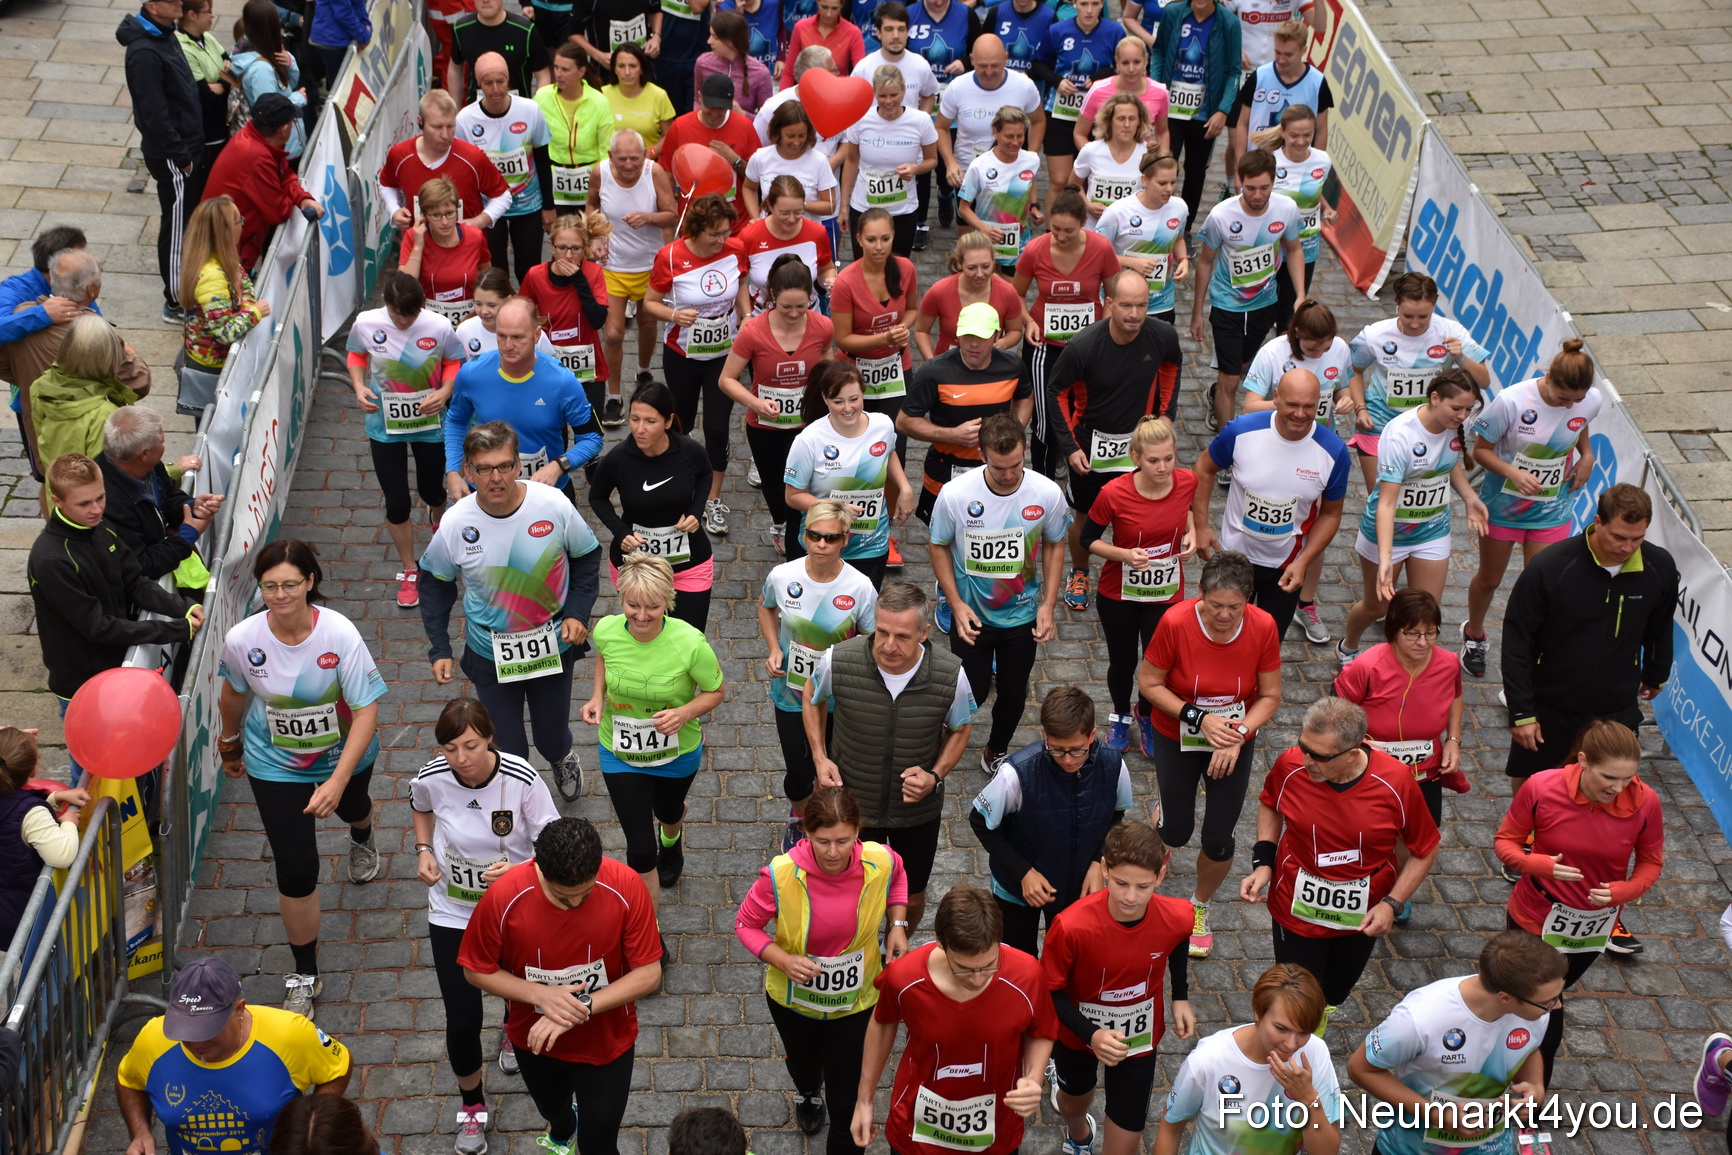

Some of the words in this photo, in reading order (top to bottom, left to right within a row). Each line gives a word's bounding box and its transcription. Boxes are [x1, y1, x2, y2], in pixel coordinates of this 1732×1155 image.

[614, 24, 643, 42] 5171
[908, 24, 930, 40] 45
[1000, 22, 1012, 35] 5
[1063, 38, 1074, 50] 8
[1059, 93, 1083, 108] 503
[1170, 90, 1202, 107] 5005
[1254, 88, 1280, 104] 66
[494, 158, 524, 174] 301
[556, 176, 589, 192] 5145
[869, 178, 904, 195] 5014
[1094, 185, 1132, 200] 5193
[1232, 253, 1272, 275] 5319
[1050, 314, 1090, 332] 5034
[692, 324, 729, 344] 5039
[863, 364, 898, 384] 5096
[1394, 379, 1424, 396] 511
[390, 402, 422, 418] 508
[1097, 441, 1127, 458] 532
[1404, 486, 1446, 507] 5077
[1248, 502, 1293, 524] 2535
[532, 524, 552, 533] Hervis
[986, 533, 1014, 541] Neumarkt
[640, 536, 684, 556] 5317
[970, 541, 1019, 560] 5025
[976, 563, 1014, 572] Alexander
[1129, 566, 1176, 586] 5087
[1136, 588, 1166, 596] Sabrina
[516, 629, 544, 640] Neumarkt
[501, 635, 552, 662] 5191
[500, 658, 559, 676] Kai-Sebastian
[794, 655, 815, 675] 51
[276, 716, 330, 736] 5041
[626, 752, 667, 762] Walburga
[1329, 854, 1348, 862] DEHN
[461, 891, 482, 901] Mela
[1302, 880, 1362, 910] 5065
[1315, 909, 1342, 922] Frank
[1551, 915, 1610, 938] 5137
[1562, 938, 1586, 948] Karin
[820, 959, 854, 968] Neumarkt
[528, 972, 554, 982] PARTL
[555, 967, 592, 981] Neumarkt
[178, 994, 202, 1004] Speed
[809, 993, 848, 1004] Gislinde
[1114, 990, 1134, 998] DEHN
[1082, 1006, 1106, 1017] PARTL
[1108, 1008, 1143, 1018] Neumarkt
[1508, 1033, 1528, 1044] Hervis
[919, 1093, 944, 1108] PARTL
[946, 1102, 982, 1112] Neumarkt
[923, 1106, 988, 1134] 5033
[933, 1130, 975, 1146] Andreas
